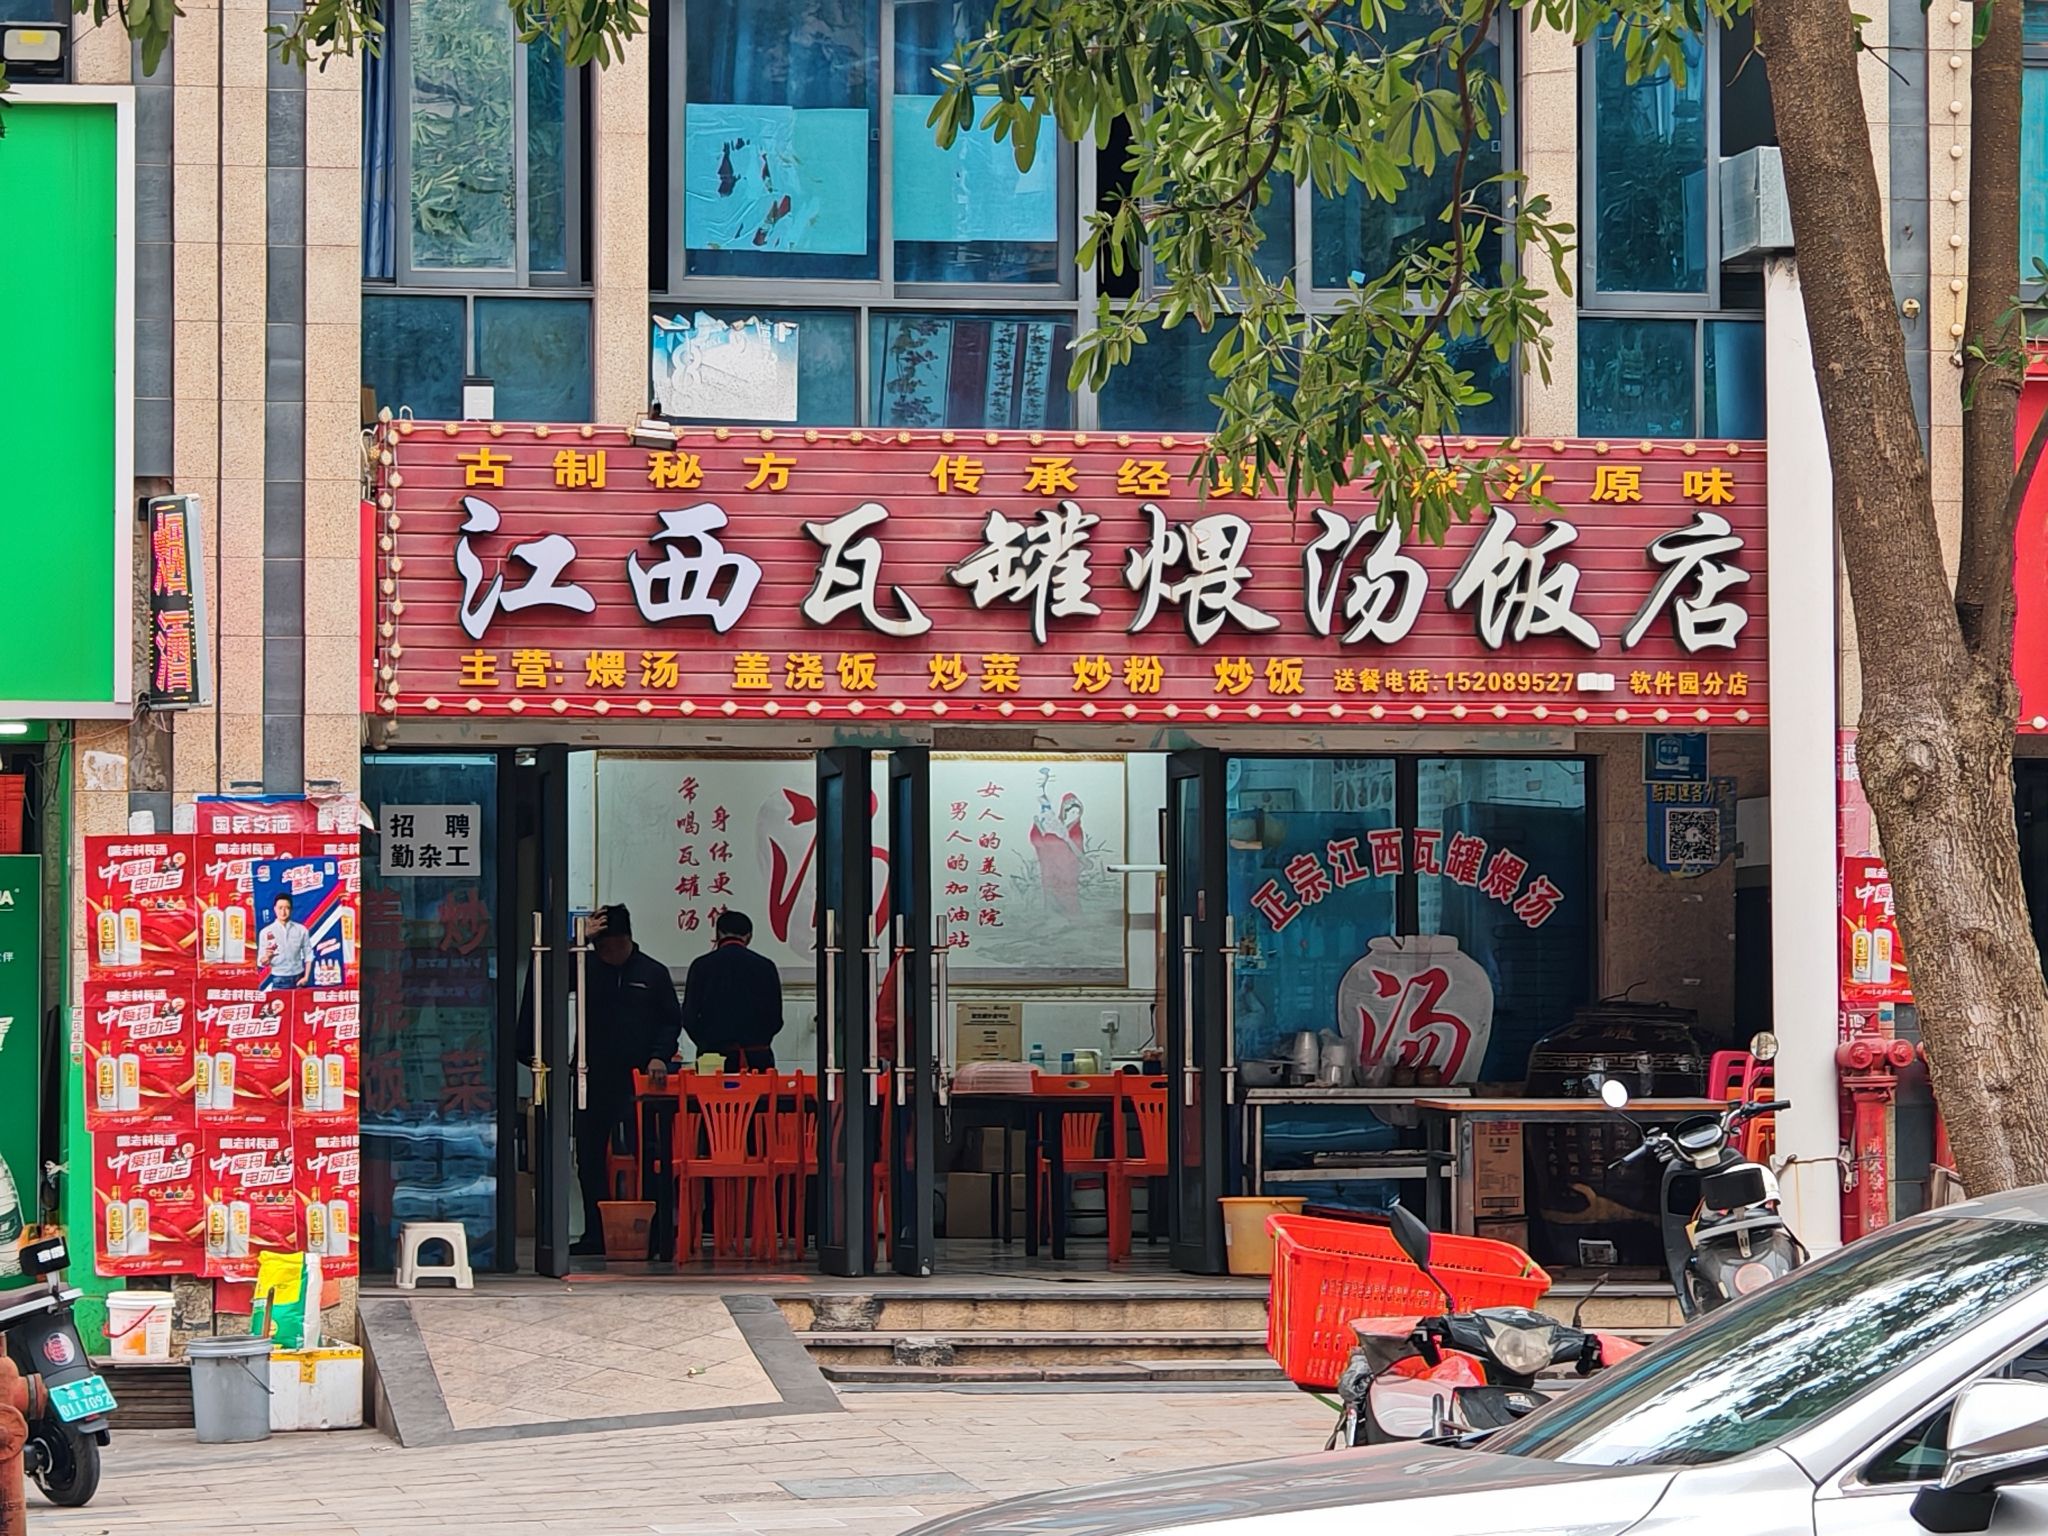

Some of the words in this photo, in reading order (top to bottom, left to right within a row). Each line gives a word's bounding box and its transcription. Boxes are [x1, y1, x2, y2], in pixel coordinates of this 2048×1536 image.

[456, 447, 798, 490] 古制秘方
[454, 494, 1753, 654] 江西瓦罐煨汤饭店
[731, 651, 879, 691] 盖浇饭
[928, 652, 1022, 692] 炒菜
[1071, 654, 1165, 694] 炒粉
[1213, 655, 1306, 695] 炒饭
[1629, 670, 1749, 697] 软件园分店
[389, 813, 472, 840] 招聘
[389, 843, 472, 869] 勤杂工
[673, 775, 701, 932] 常喝瓦罐汤
[706, 804, 735, 950] 身体更
[944, 800, 972, 950] 男人的加油站
[976, 780, 1005, 928] 女人的美容院
[1249, 826, 1565, 932] 正宗江西瓦罐煨汤
[1357, 966, 1472, 1087] 汤
